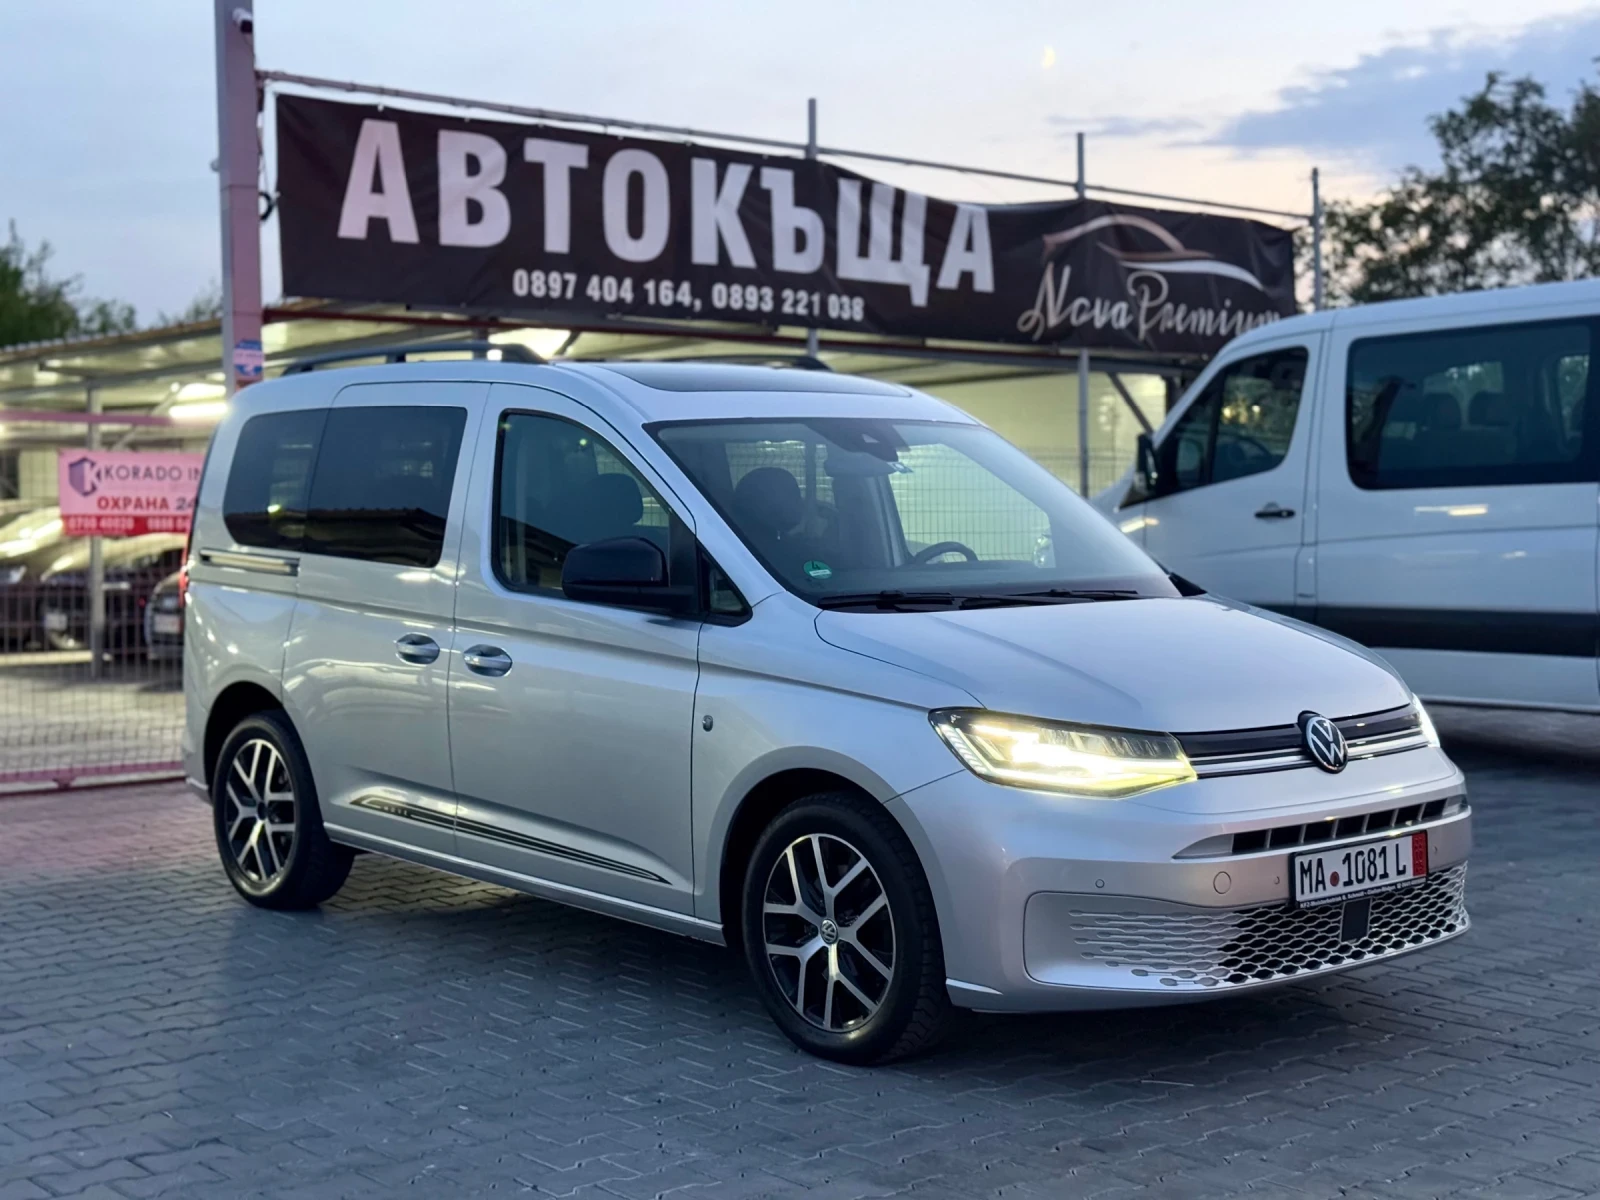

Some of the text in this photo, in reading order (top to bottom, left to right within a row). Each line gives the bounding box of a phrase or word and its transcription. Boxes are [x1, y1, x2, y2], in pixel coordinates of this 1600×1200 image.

[338, 118, 994, 307] АВТОКЪЩА
[512, 268, 865, 322] 0897 404 164, 0893 221 038
[1017, 261, 1134, 342] Nova
[104, 465, 182, 481] KORADO
[97, 497, 169, 511] ОХРАНА
[1300, 858, 1326, 895] MA
[1342, 846, 1389, 887] 1081
[1395, 843, 1406, 876] L
